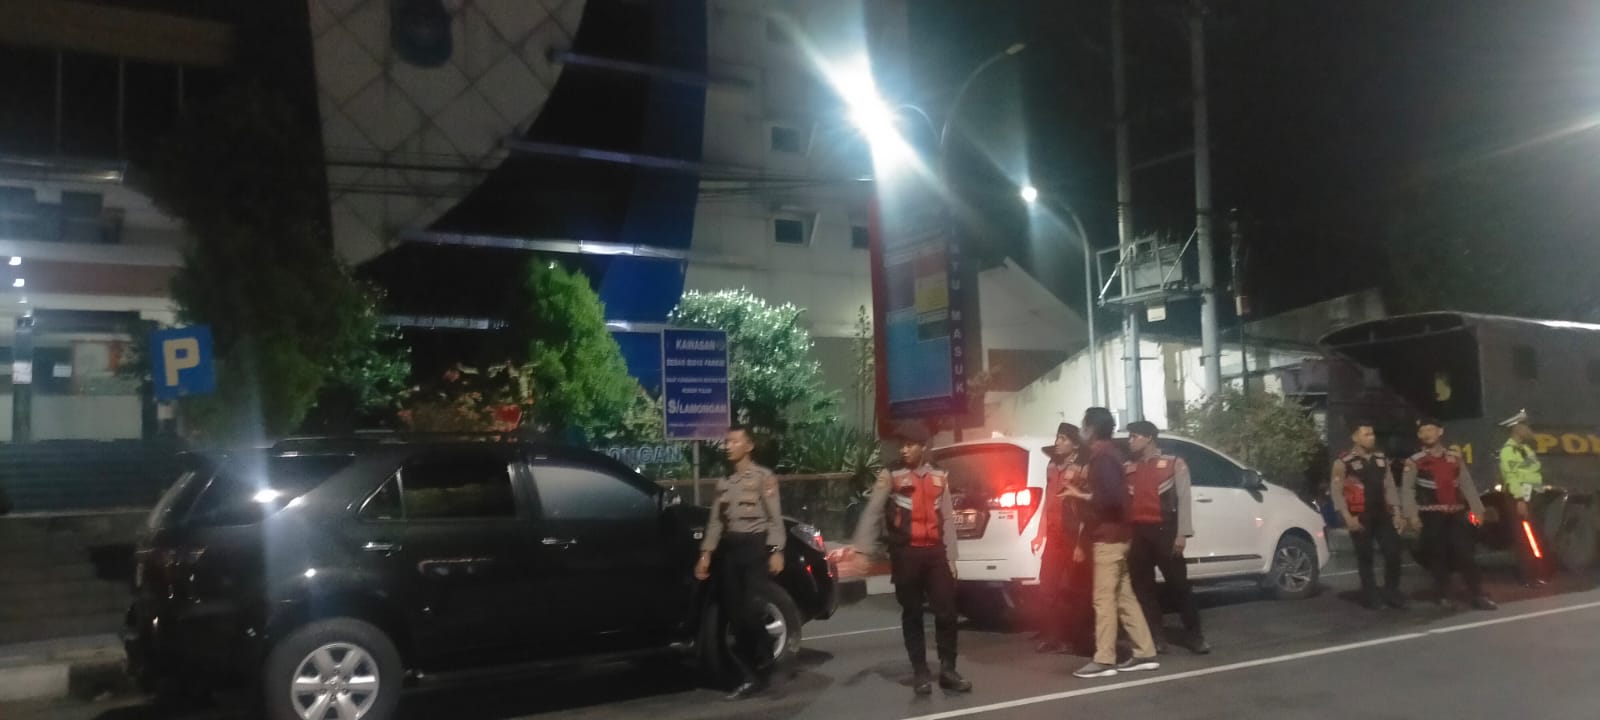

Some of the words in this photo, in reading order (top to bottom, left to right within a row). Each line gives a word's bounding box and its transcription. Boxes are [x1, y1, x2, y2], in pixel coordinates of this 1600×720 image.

[163, 337, 200, 387] P
[675, 339, 716, 350] KAWASAN
[951, 311, 964, 393] MASUK
